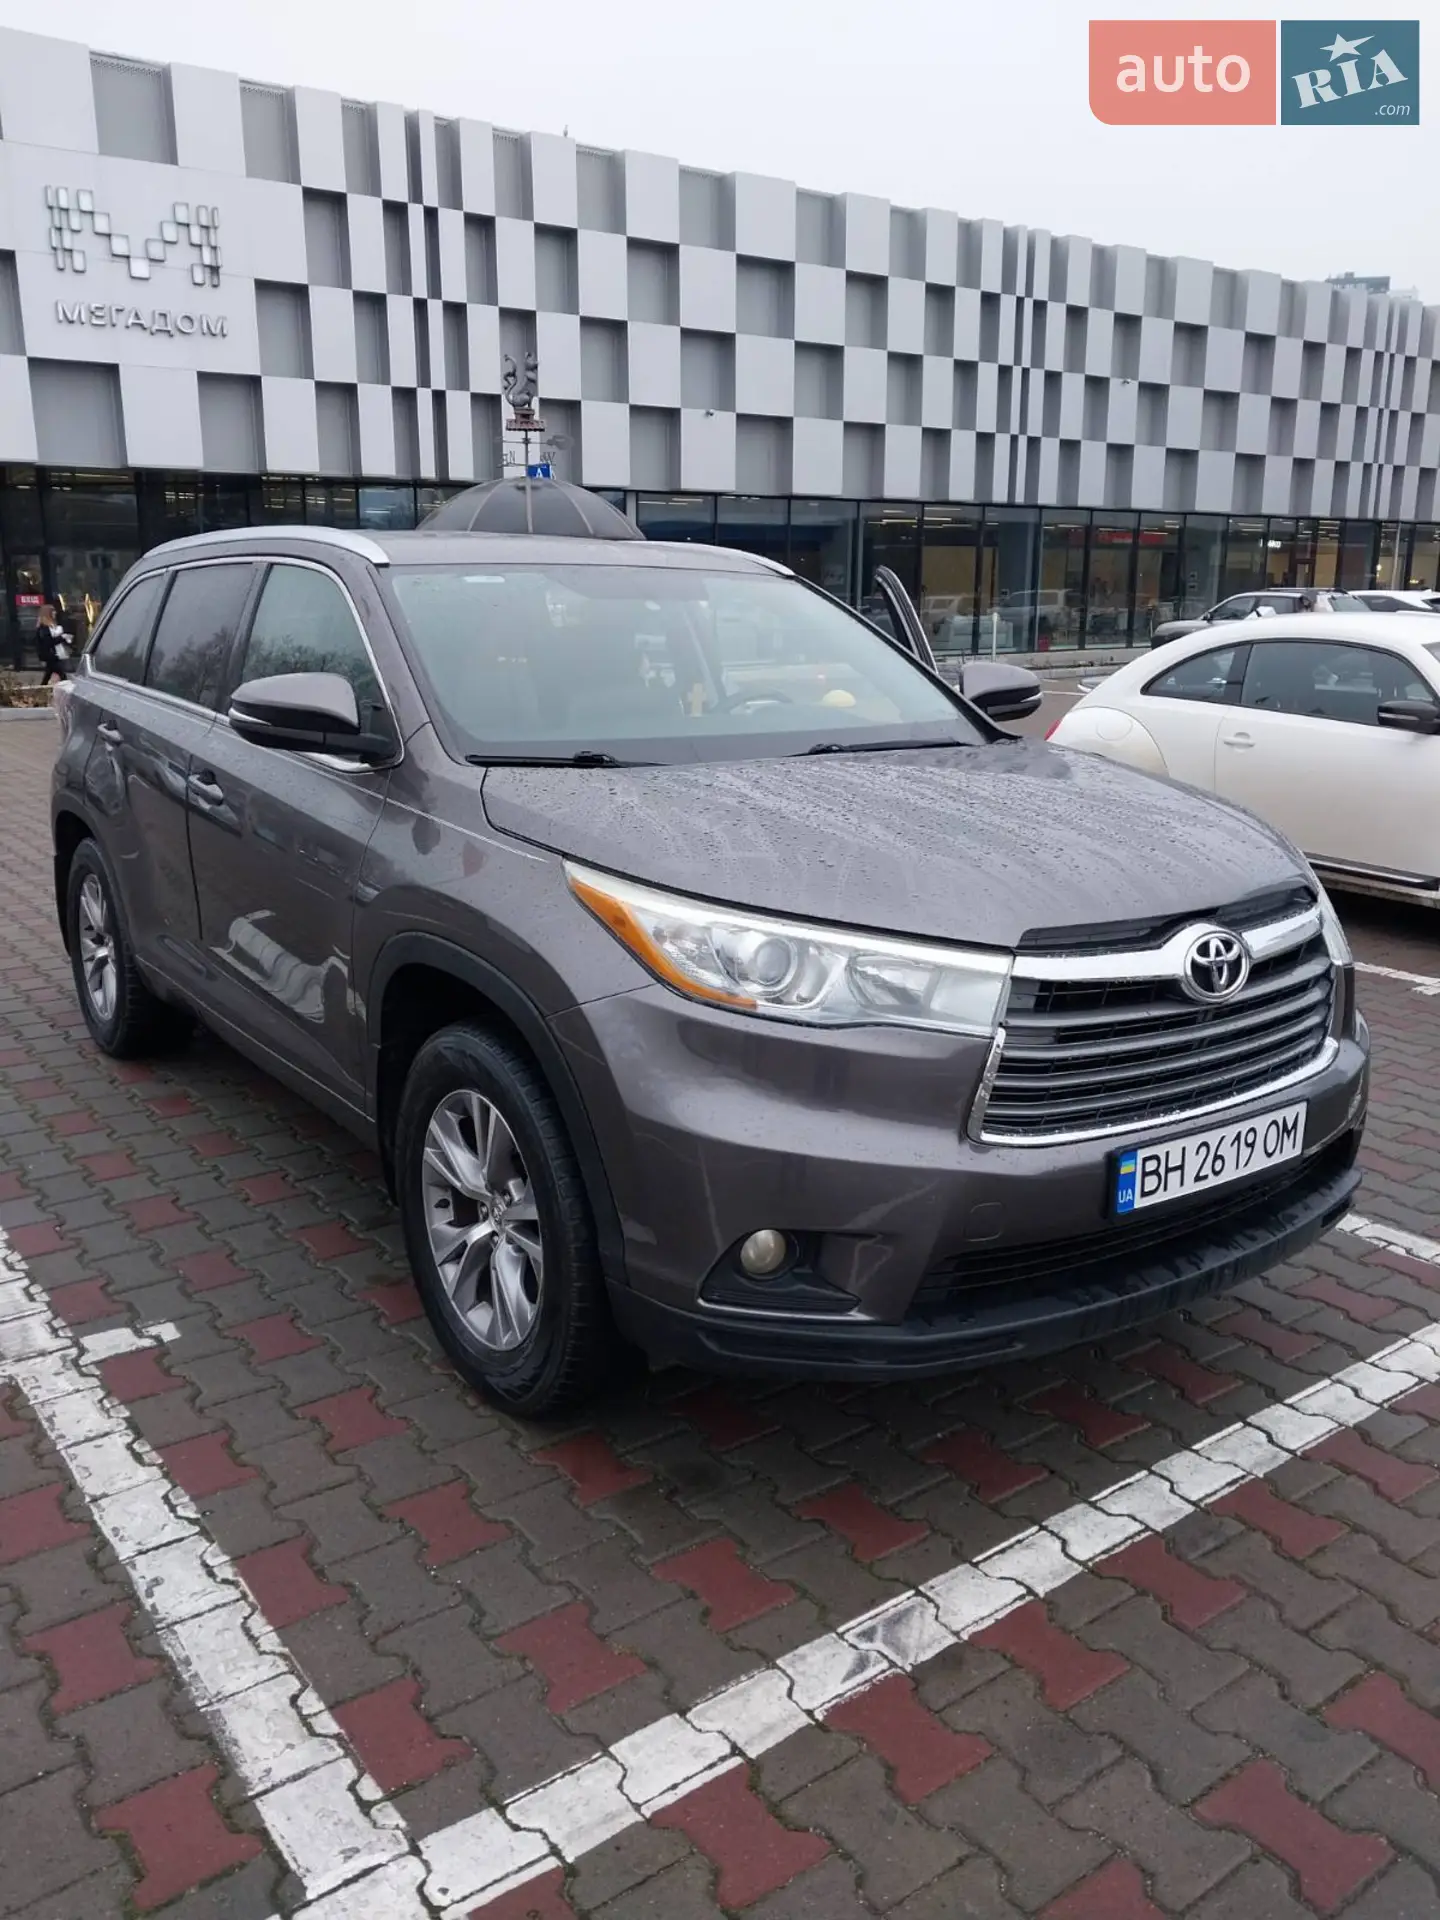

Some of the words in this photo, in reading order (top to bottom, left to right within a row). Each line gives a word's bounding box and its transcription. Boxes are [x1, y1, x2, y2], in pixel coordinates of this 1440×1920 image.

[56, 300, 228, 338] МЕГАДОМ
[1139, 1145, 1187, 1199] BH
[1193, 1126, 1258, 1185] 2619
[1263, 1111, 1300, 1159] OM
[1118, 1189, 1134, 1204] UA
